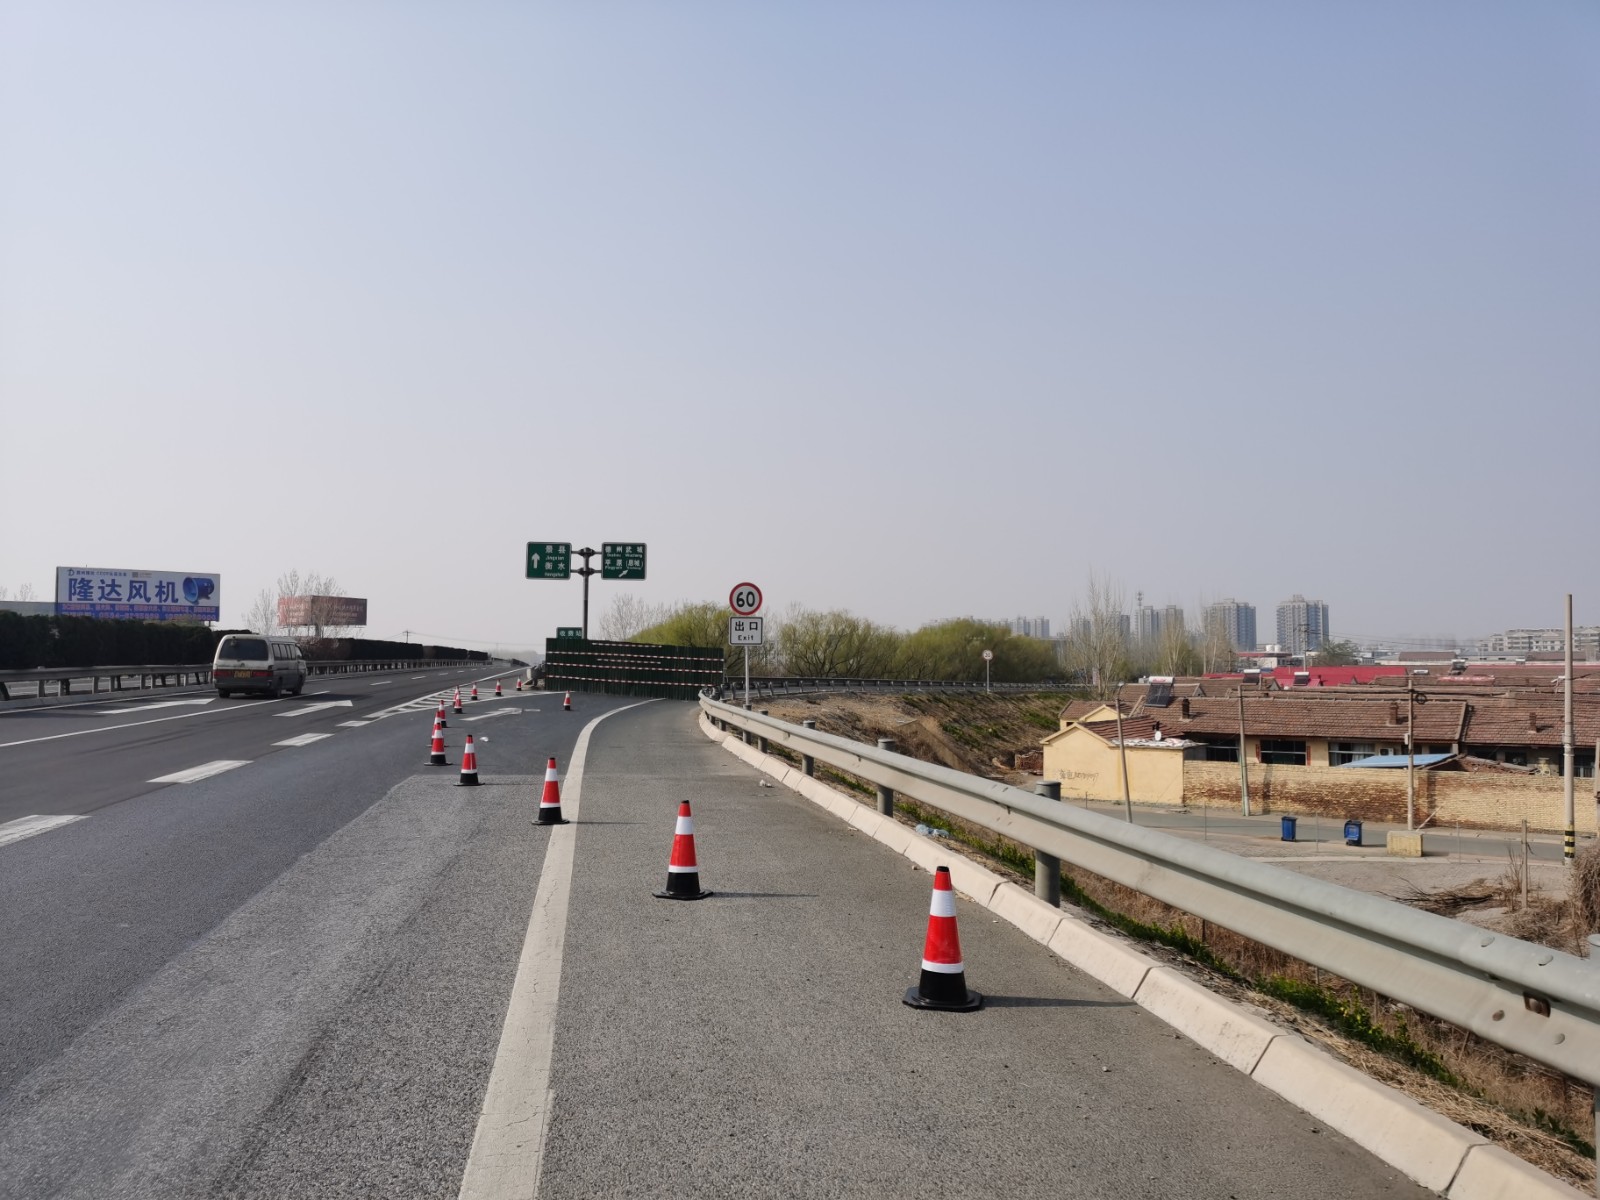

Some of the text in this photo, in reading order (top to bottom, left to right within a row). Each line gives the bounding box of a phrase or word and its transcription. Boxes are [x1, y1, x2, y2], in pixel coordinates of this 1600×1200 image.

[544, 545, 566, 554] 景县
[544, 561, 566, 571] 衡水
[68, 577, 179, 604] 隆达风机
[736, 591, 755, 607] 60
[734, 620, 758, 632] 出口
